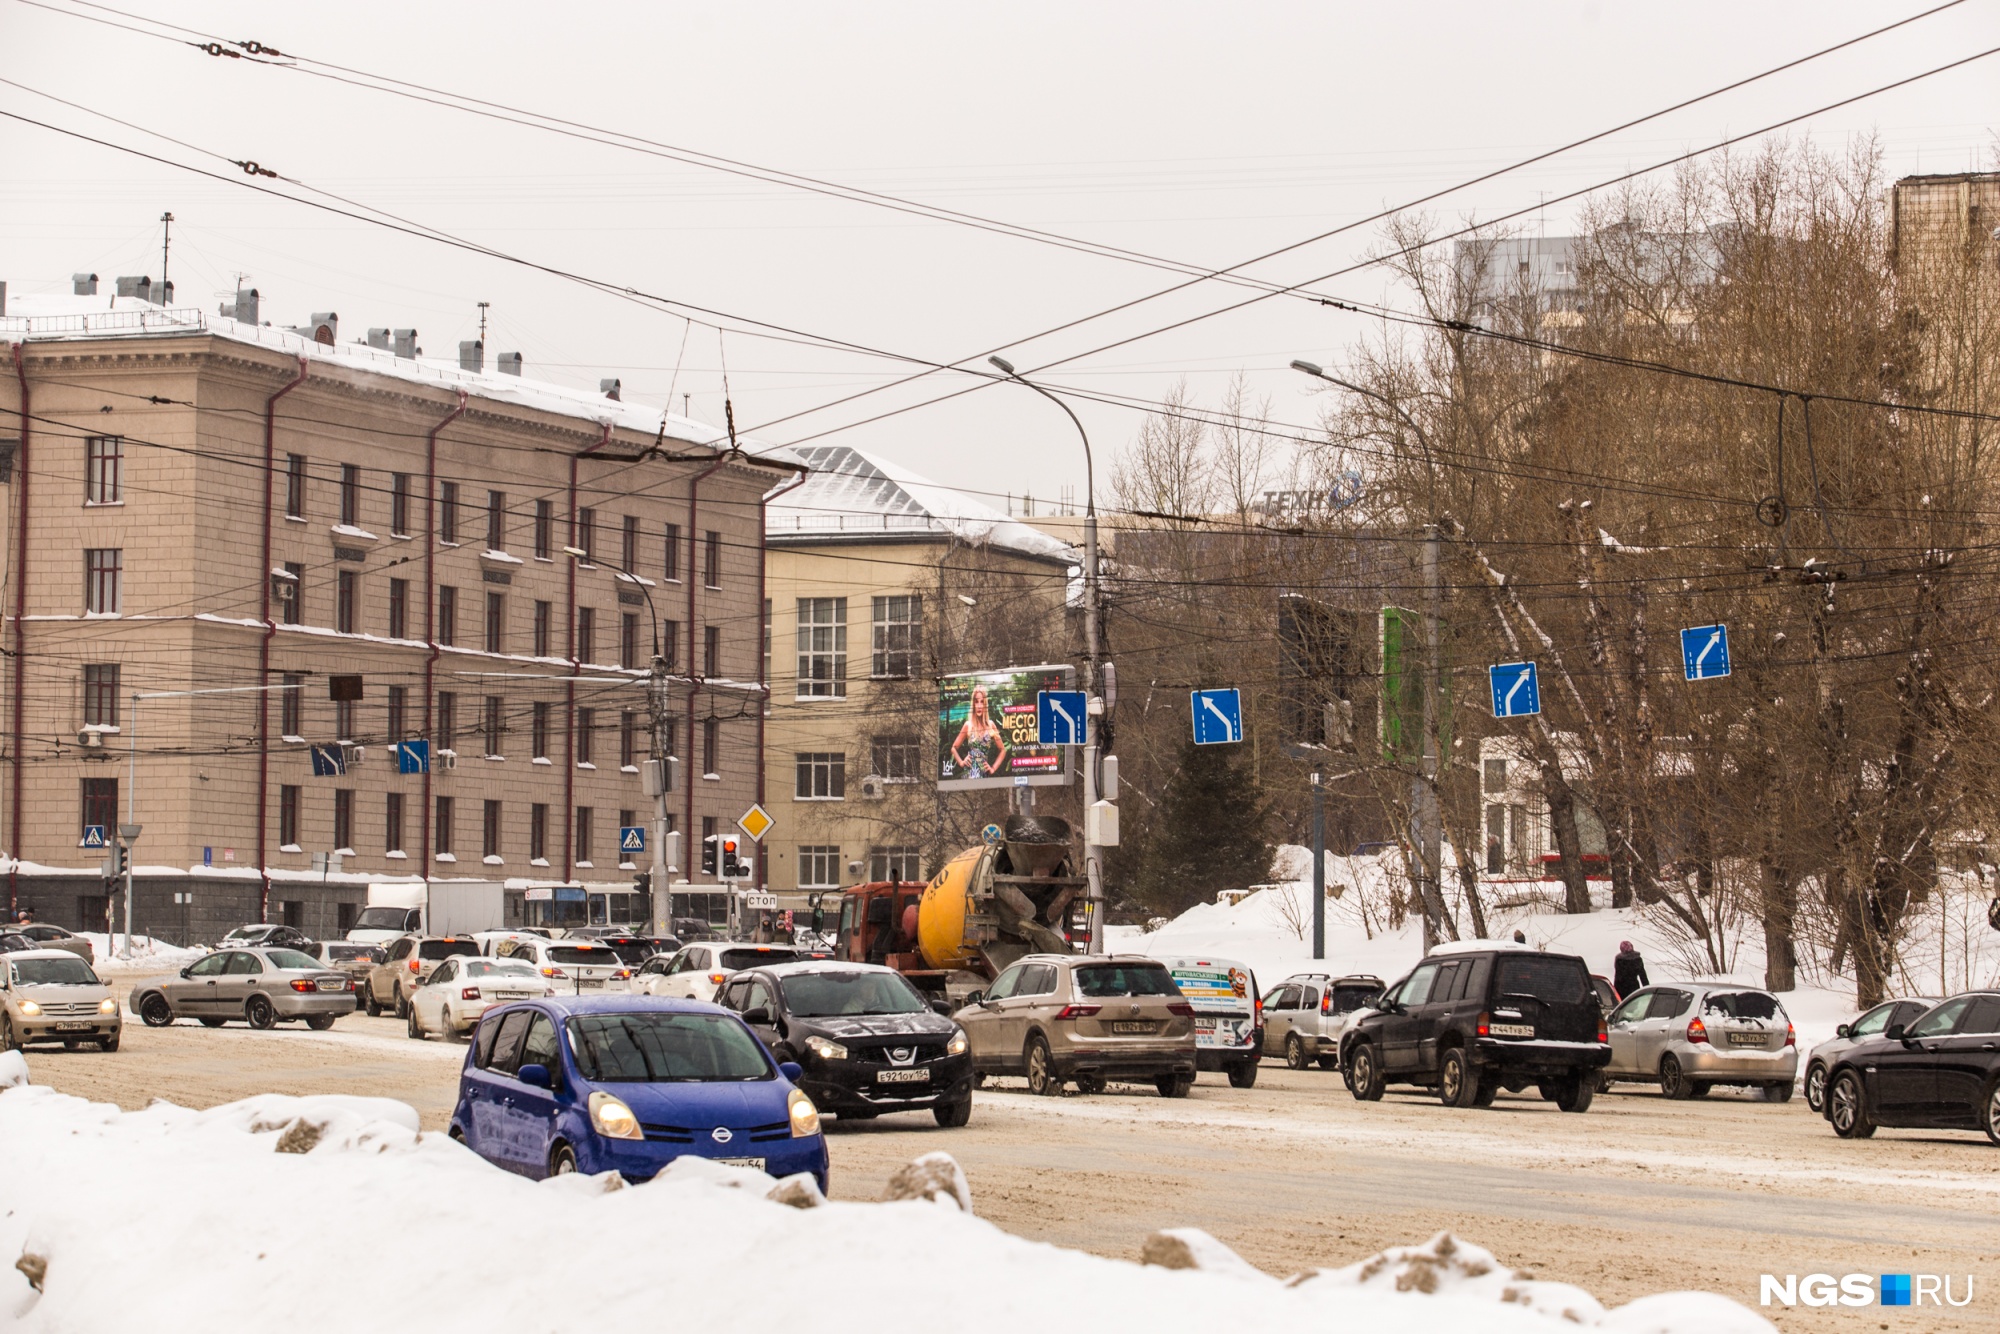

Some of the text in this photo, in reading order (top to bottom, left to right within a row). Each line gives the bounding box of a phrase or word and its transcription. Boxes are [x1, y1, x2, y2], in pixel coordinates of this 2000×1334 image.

[1002, 713, 1036, 729] МЕСТО
[943, 760, 954, 772] 16+
[748, 897, 776, 905] СТОП
